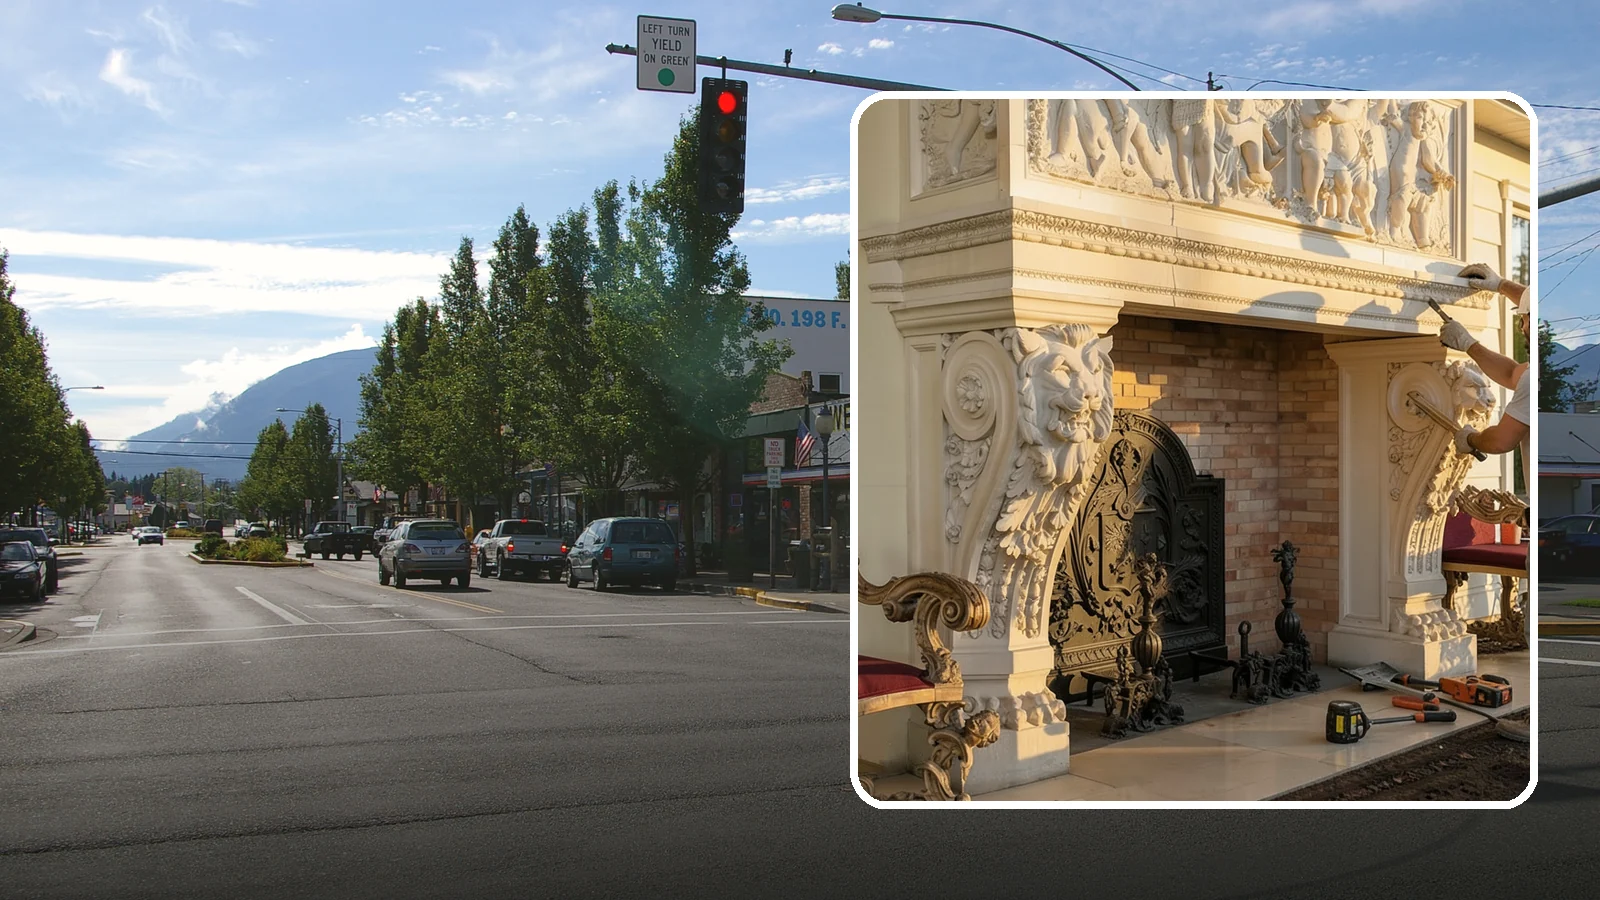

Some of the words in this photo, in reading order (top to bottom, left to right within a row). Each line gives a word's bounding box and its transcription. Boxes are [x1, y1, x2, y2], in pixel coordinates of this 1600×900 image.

[642, 23, 663, 35] LEFT
[668, 25, 690, 37] TURN
[652, 37, 682, 52] YIELD
[644, 53, 656, 64] ON
[661, 54, 688, 66] GREEN
[791, 309, 827, 328] 198
[831, 311, 847, 329] F.
